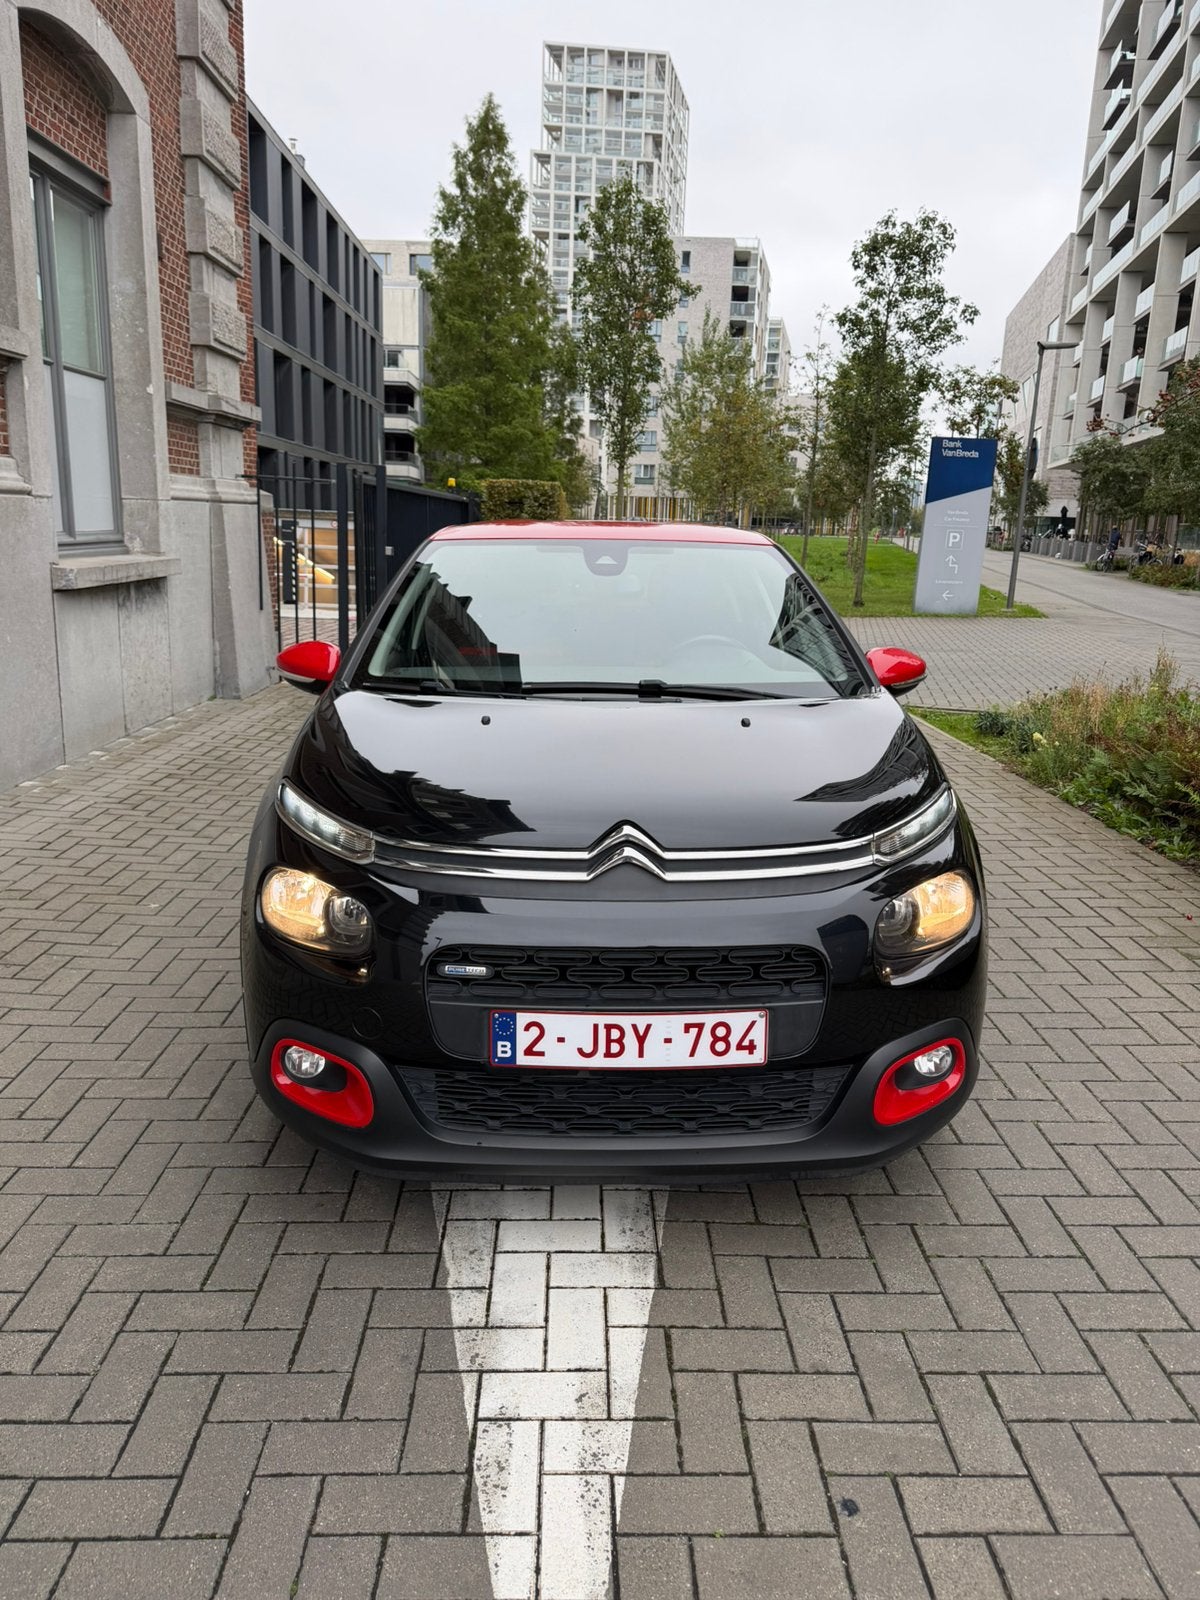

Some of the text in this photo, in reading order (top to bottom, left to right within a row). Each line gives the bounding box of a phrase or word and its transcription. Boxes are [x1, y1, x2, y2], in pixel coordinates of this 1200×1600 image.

[942, 439, 962, 448] Bank
[941, 448, 979, 458] VanBreda
[948, 532, 960, 547] P
[523, 1019, 758, 1059] 2-JBY-784
[497, 1040, 512, 1058] B
